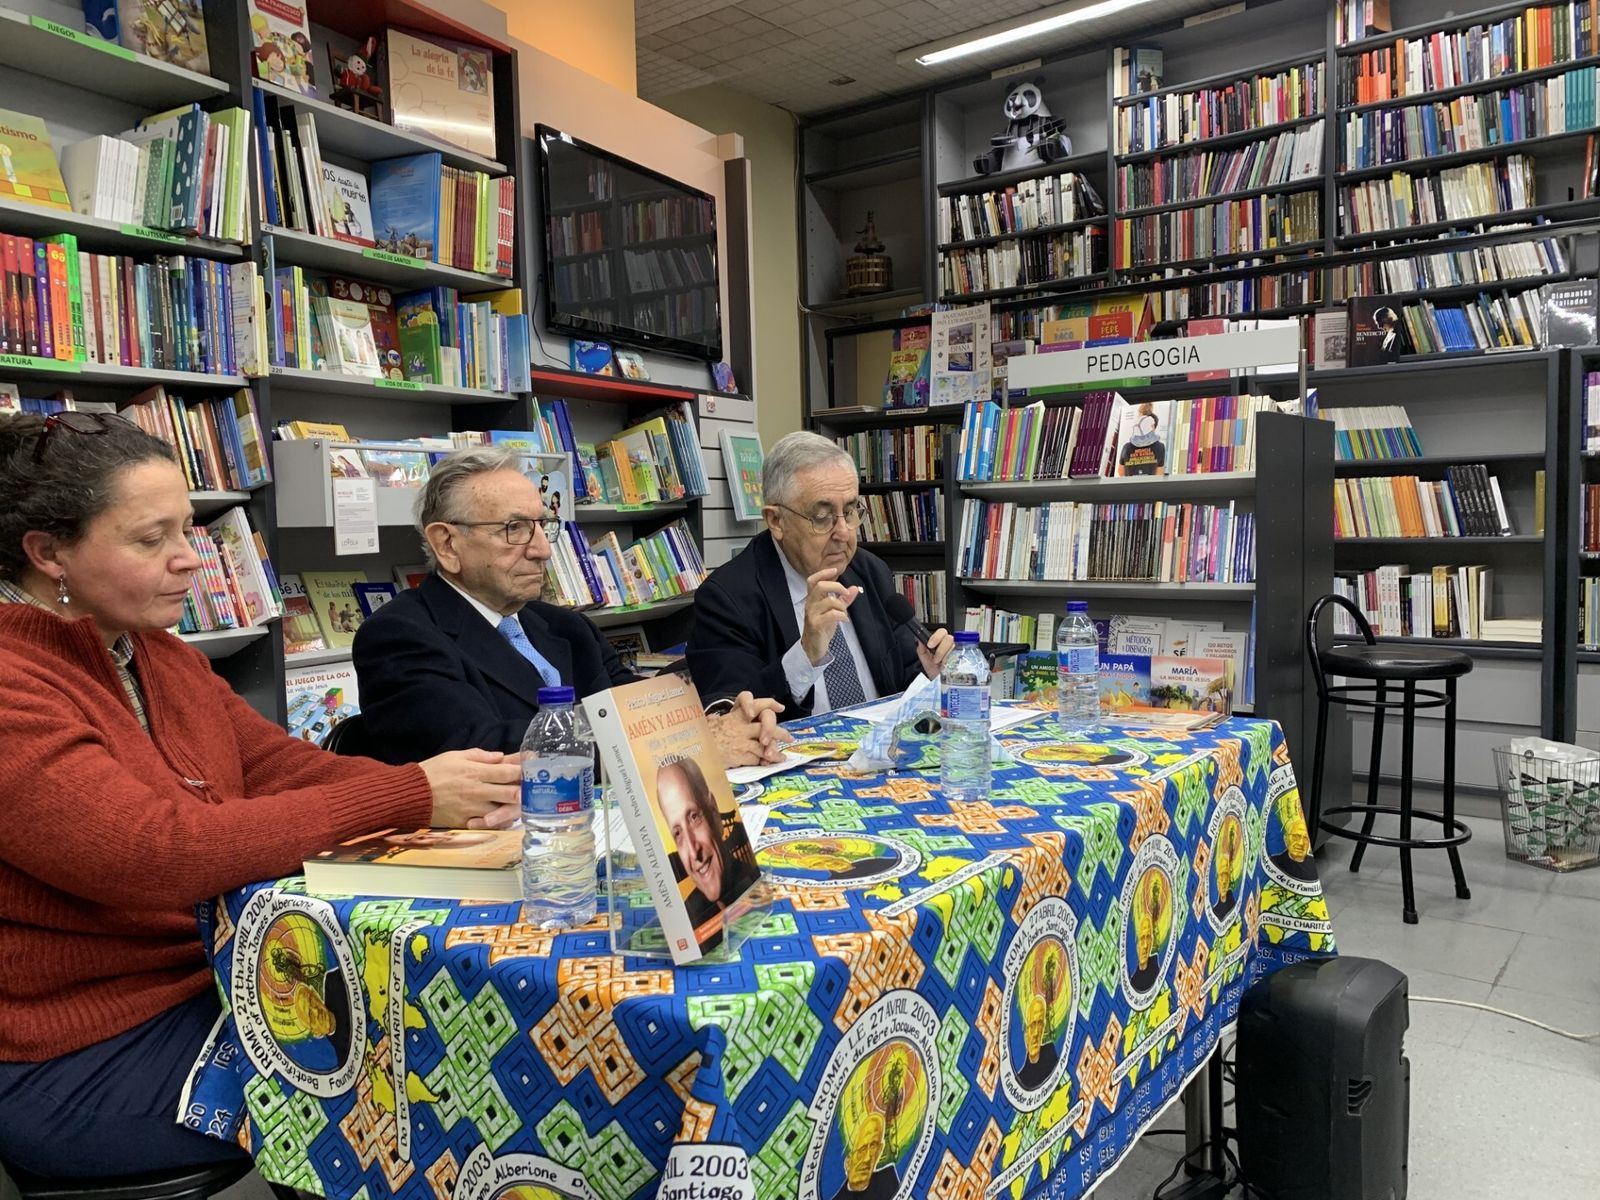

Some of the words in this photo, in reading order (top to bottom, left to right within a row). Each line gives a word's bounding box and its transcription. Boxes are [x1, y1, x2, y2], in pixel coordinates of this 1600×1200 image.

[47, 23, 76, 39] JUEGOS
[373, 251, 386, 261] VIDAS
[394, 255, 411, 265] SANTOS
[1551, 290, 1592, 299] Diamantes
[1087, 344, 1201, 374] PEDAGOGIA
[1126, 635, 1152, 644] MÉTODOS
[286, 678, 294, 686] EL
[294, 676, 315, 685] JUEGO
[317, 674, 325, 682] DE
[1113, 661, 1135, 672] PAPÁ
[1171, 667, 1198, 675] MARÍA
[295, 685, 306, 693] vida
[950, 688, 961, 718] FONTECELTA
[627, 715, 657, 740] AMÉN
[655, 715, 665, 730] Y
[666, 704, 704, 728] ALELUYA
[612, 743, 625, 767] Lamet
[619, 769, 636, 798] Miguel
[628, 798, 641, 818] Pedro
[638, 825, 659, 871] ALELUYA
[653, 869, 662, 879] Y
[658, 877, 673, 909] AMÉN
[237, 925, 252, 962] APRIL
[247, 890, 275, 926] 2003
[1029, 910, 1038, 929] 27
[1039, 903, 1056, 920] ABRIL
[1057, 905, 1075, 932] 2003
[1262, 917, 1280, 925] tous
[1282, 918, 1292, 926] la
[1294, 919, 1326, 931] CHARITÉ
[252, 915, 269, 954] James
[393, 922, 417, 970] TRUTH
[246, 963, 256, 1010] father
[342, 953, 362, 1011] Pauline
[393, 976, 402, 991] of
[255, 1014, 264, 1027] of
[394, 998, 404, 1064] CHARITY
[848, 1022, 866, 1050] LE
[870, 1008, 885, 1029] 27
[885, 997, 909, 1016] AVRIL
[910, 1001, 937, 1037] 2003
[260, 1028, 319, 1090] Beatification
[804, 1067, 849, 1184] Béatification
[852, 1047, 865, 1063] du
[867, 1026, 889, 1048] Père
[889, 1018, 921, 1039] Jacques
[919, 1037, 937, 1102] Alberione
[1004, 1071, 1028, 1104] Fundador
[1027, 1096, 1034, 1107] de
[400, 1101, 407, 1121] to
[400, 1127, 408, 1147] Do
[462, 1152, 492, 1195] 2003
[494, 1161, 558, 1184] Alberione
[690, 1155, 748, 1180] 2003
